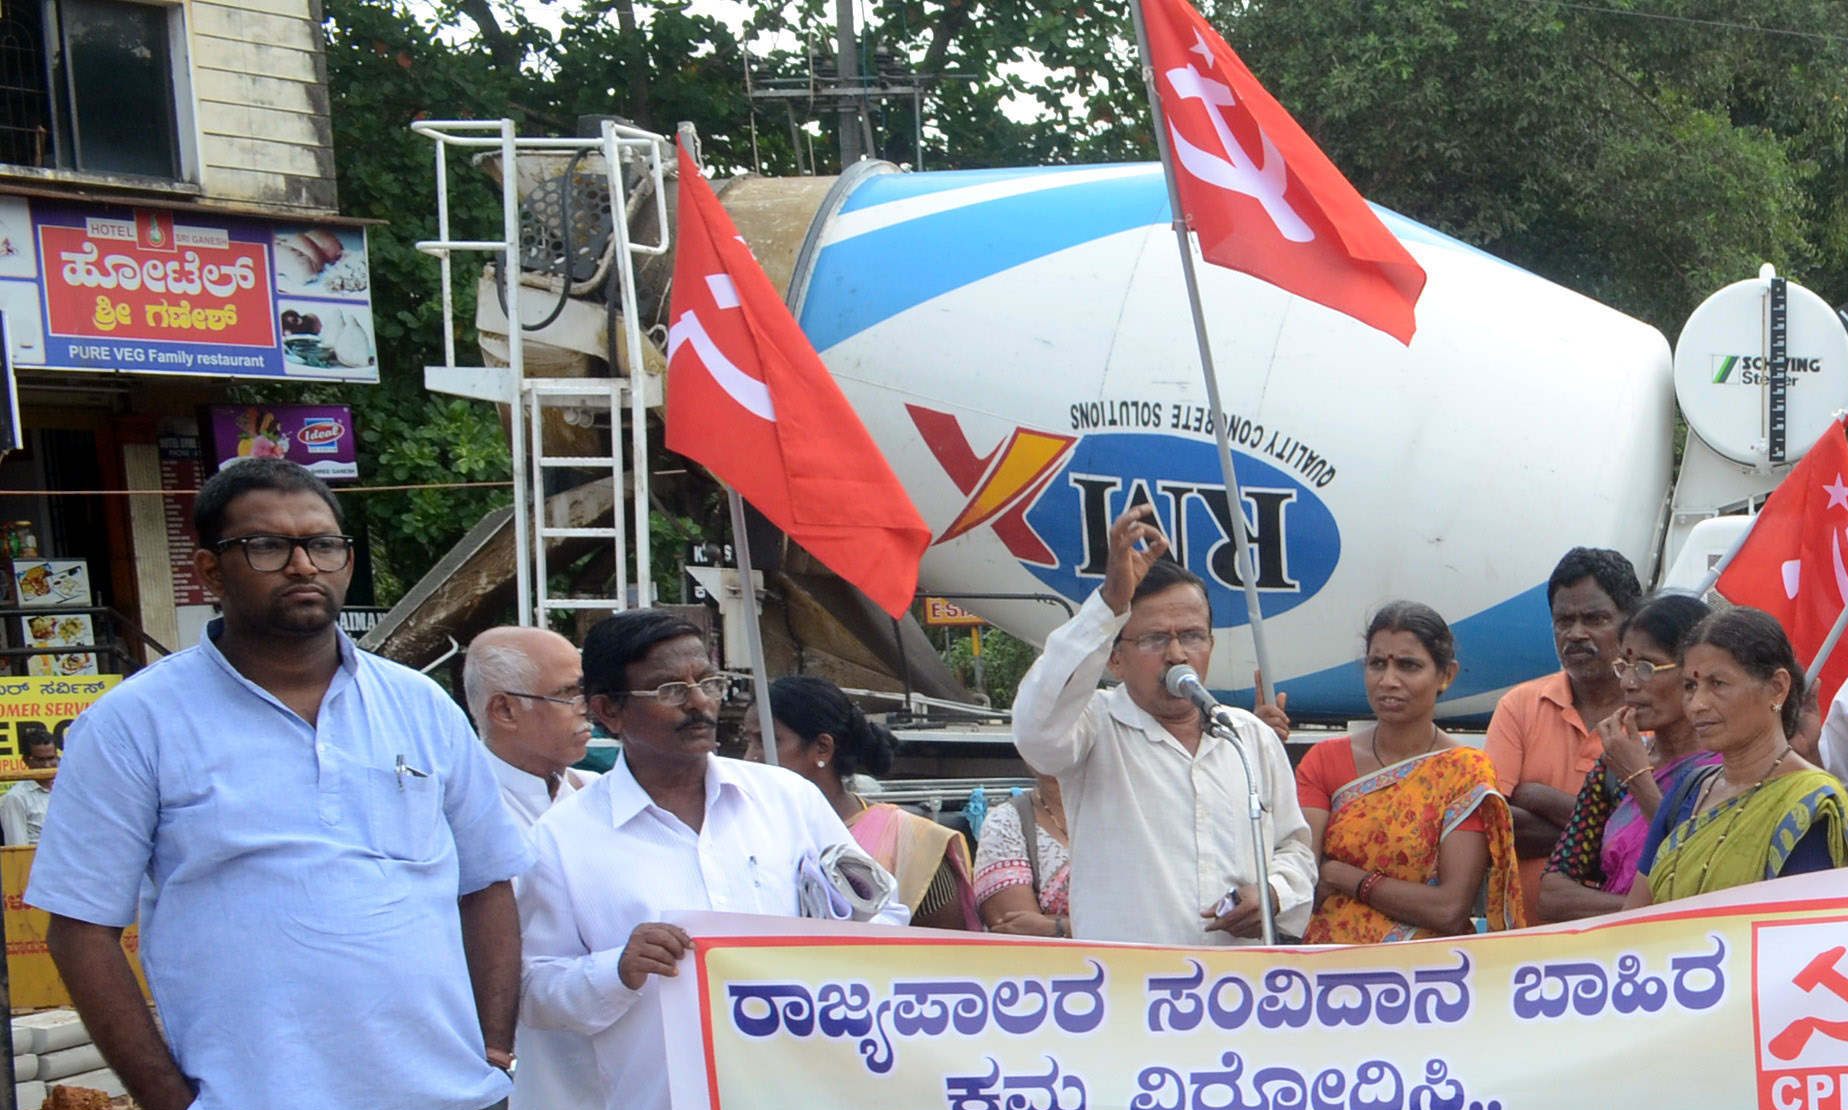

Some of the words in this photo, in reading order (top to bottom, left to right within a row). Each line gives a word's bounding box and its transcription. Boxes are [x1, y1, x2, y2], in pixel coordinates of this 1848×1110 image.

[90, 222, 135, 239] HOTEL
[176, 234, 190, 244] SRI
[191, 235, 228, 247] GANESH
[60, 241, 256, 298] ಹೋಟೆಲ್
[92, 295, 132, 332] ಶ್ರೀ
[145, 299, 238, 331] ಗಣೇಶ್
[68, 344, 111, 361] PURE
[113, 347, 146, 363] VEG
[149, 349, 194, 368] Family
[197, 353, 265, 369] restaurant
[1070, 400, 1162, 430] SOLUTIONS
[1171, 404, 1264, 448] CONRETE
[1264, 430, 1337, 489] QUALITY
[727, 957, 1106, 1075] ರಾಜ್ಯಪಾಲರ
[1147, 949, 1471, 1032] ಸಂವಿದಾನ
[1513, 935, 1727, 1021] ಬಾಹಿರ
